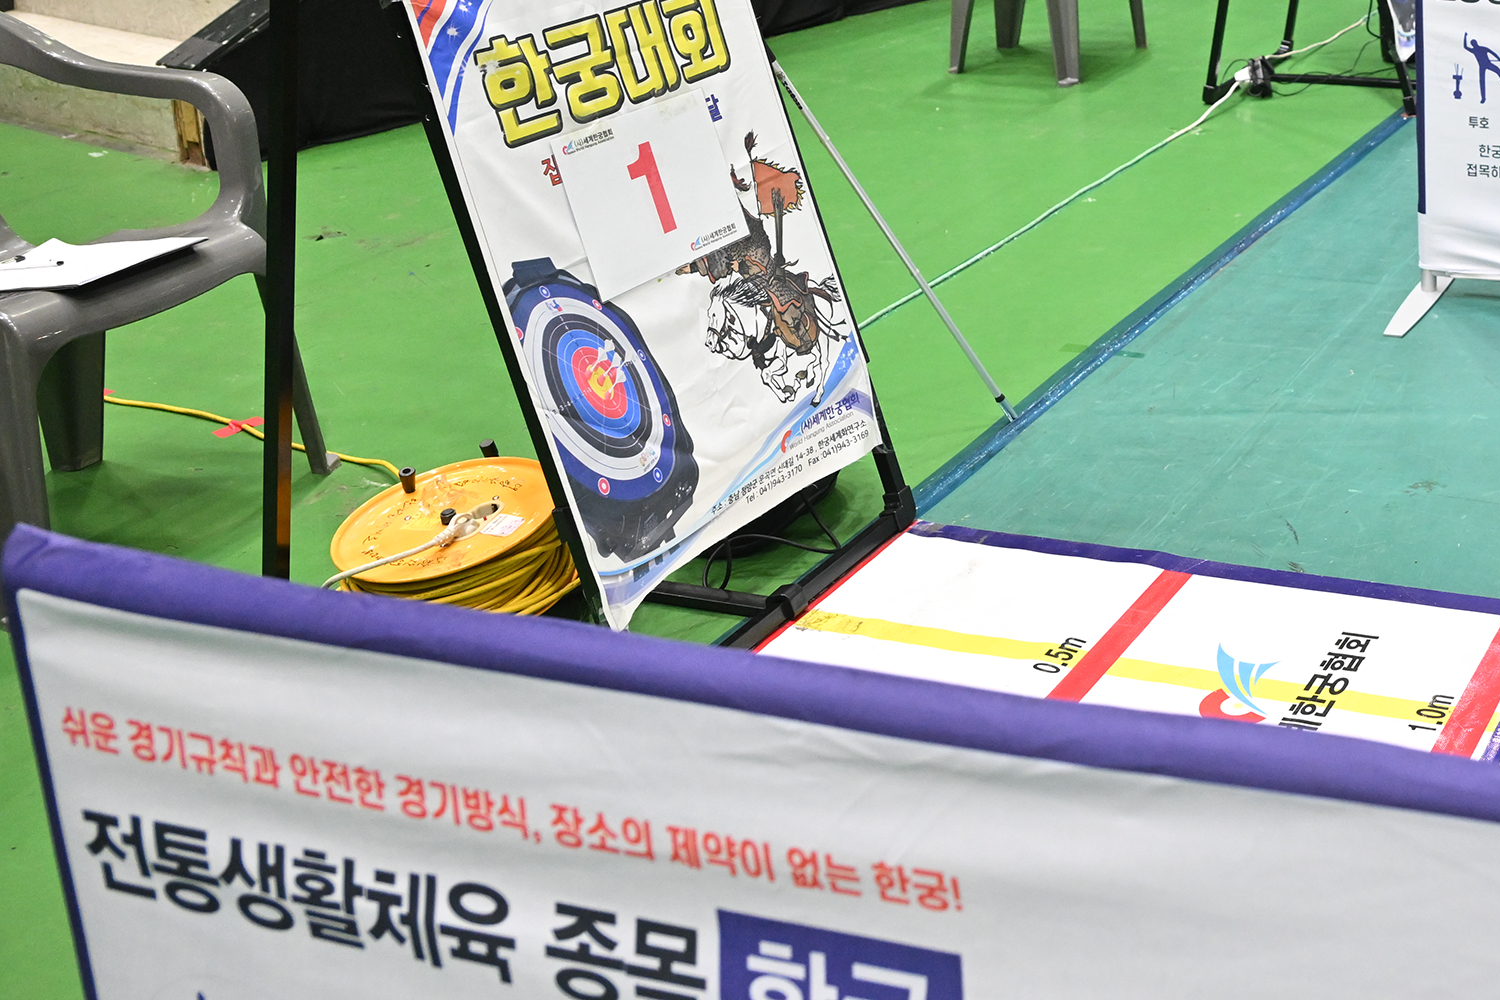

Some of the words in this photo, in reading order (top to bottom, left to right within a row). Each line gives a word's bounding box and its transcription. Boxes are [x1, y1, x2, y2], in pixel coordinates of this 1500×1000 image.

[1468, 116, 1489, 129] 투호
[627, 141, 677, 234] 1
[800, 392, 860, 434] (사)세계한궁협회
[818, 420, 867, 449] 한궁세계화연구소
[1032, 635, 1088, 675] 0.5m
[1408, 693, 1455, 732] 1.0m
[62, 705, 121, 752] 쉬운
[127, 716, 281, 789] 경기규칙과
[289, 751, 385, 813] 안전한
[396, 772, 542, 846] 경기방식,
[551, 802, 655, 862] 장소의
[668, 822, 776, 884] 제약이
[785, 845, 862, 898] 없는
[871, 859, 963, 913] 한궁!
[82, 808, 517, 984] 전통생활체육
[545, 902, 708, 1000] 종목
